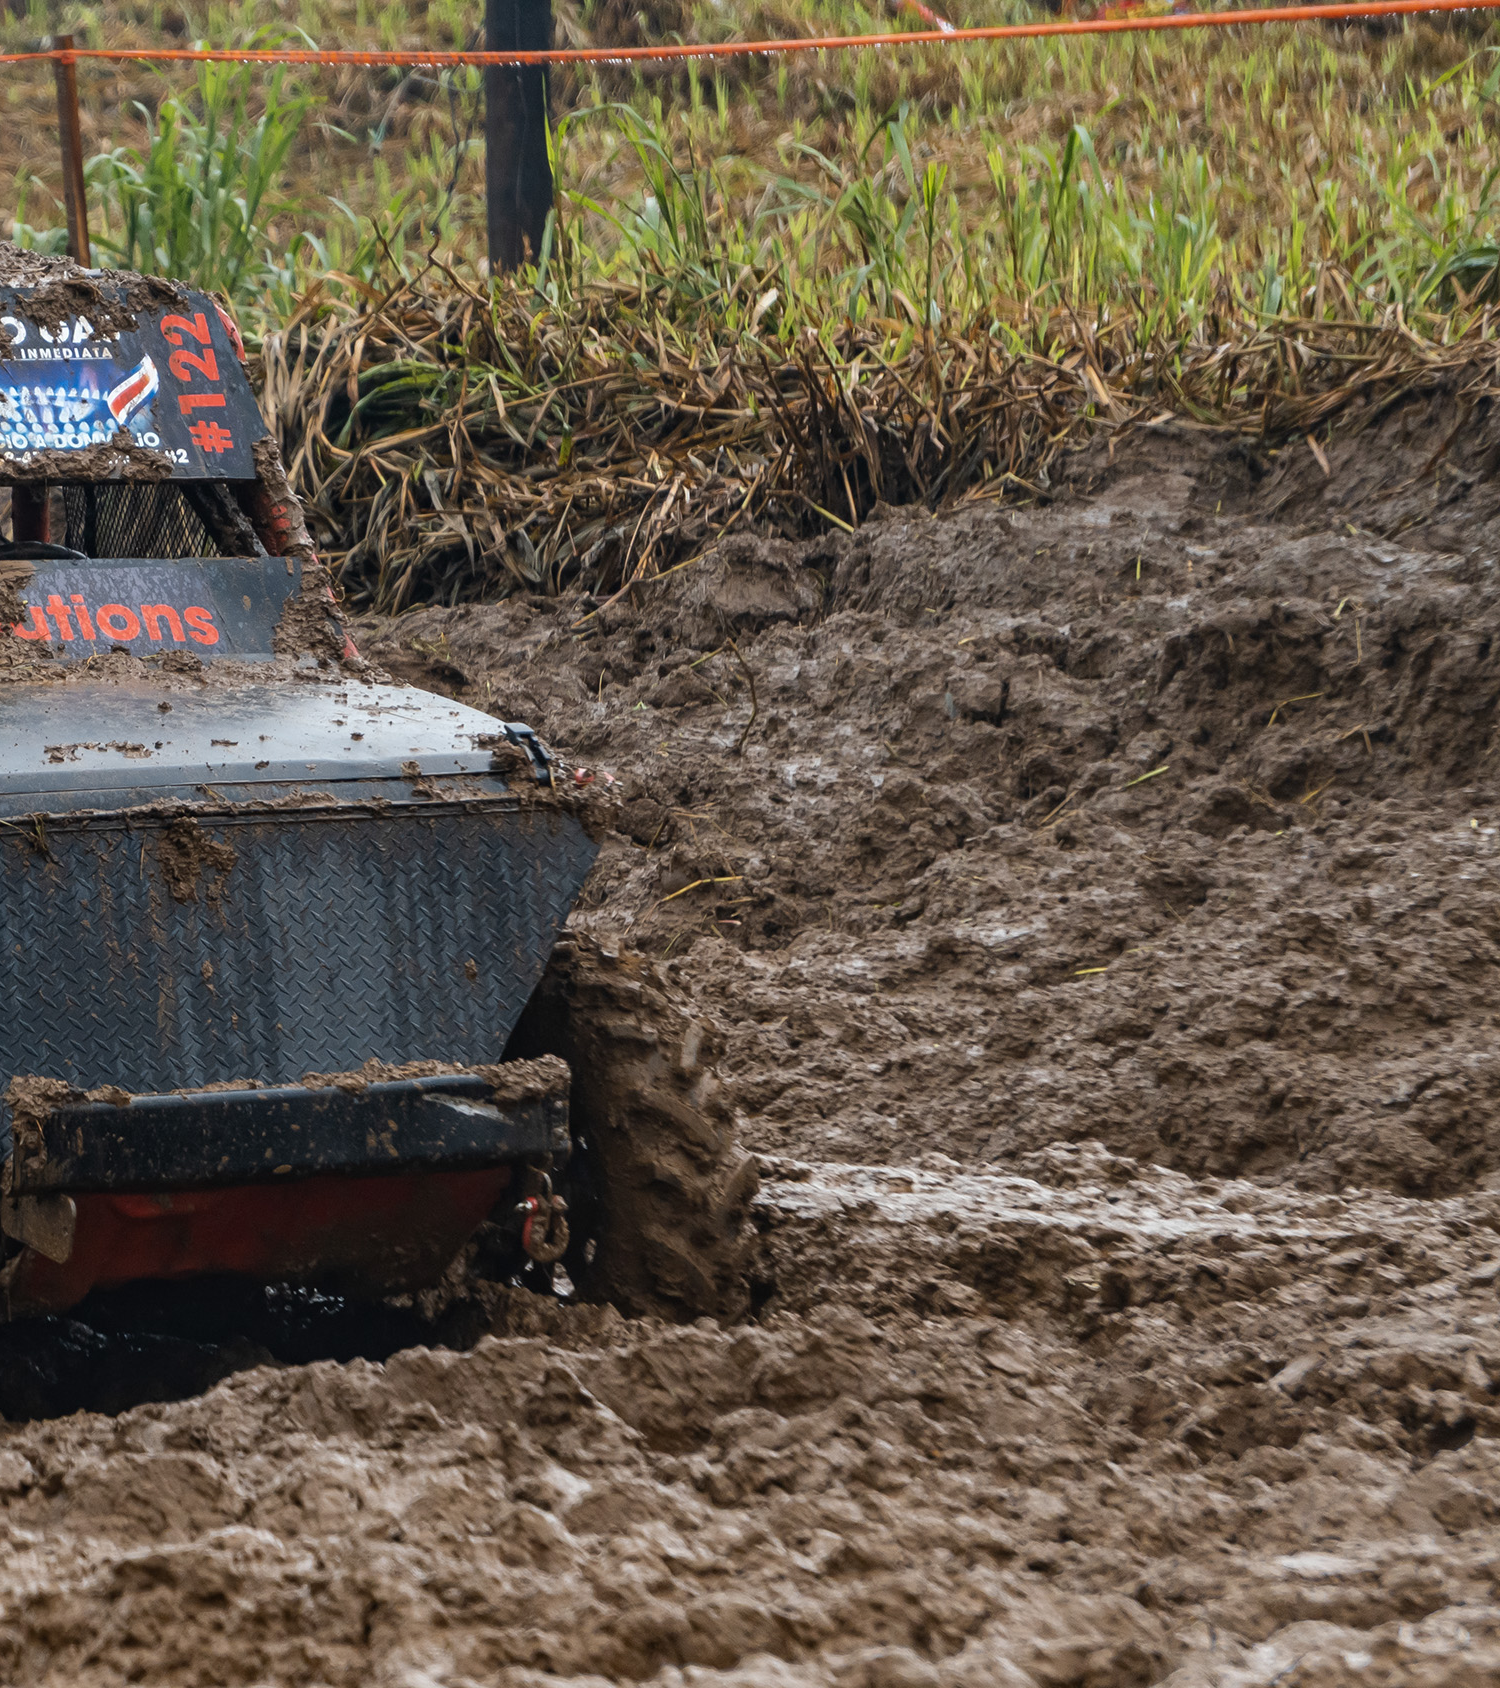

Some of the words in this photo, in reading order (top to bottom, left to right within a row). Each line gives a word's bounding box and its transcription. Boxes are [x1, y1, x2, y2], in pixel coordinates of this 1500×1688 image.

[20, 347, 114, 360] INMEDIATA
[160, 312, 234, 453] #122
[36, 434, 47, 448] A
